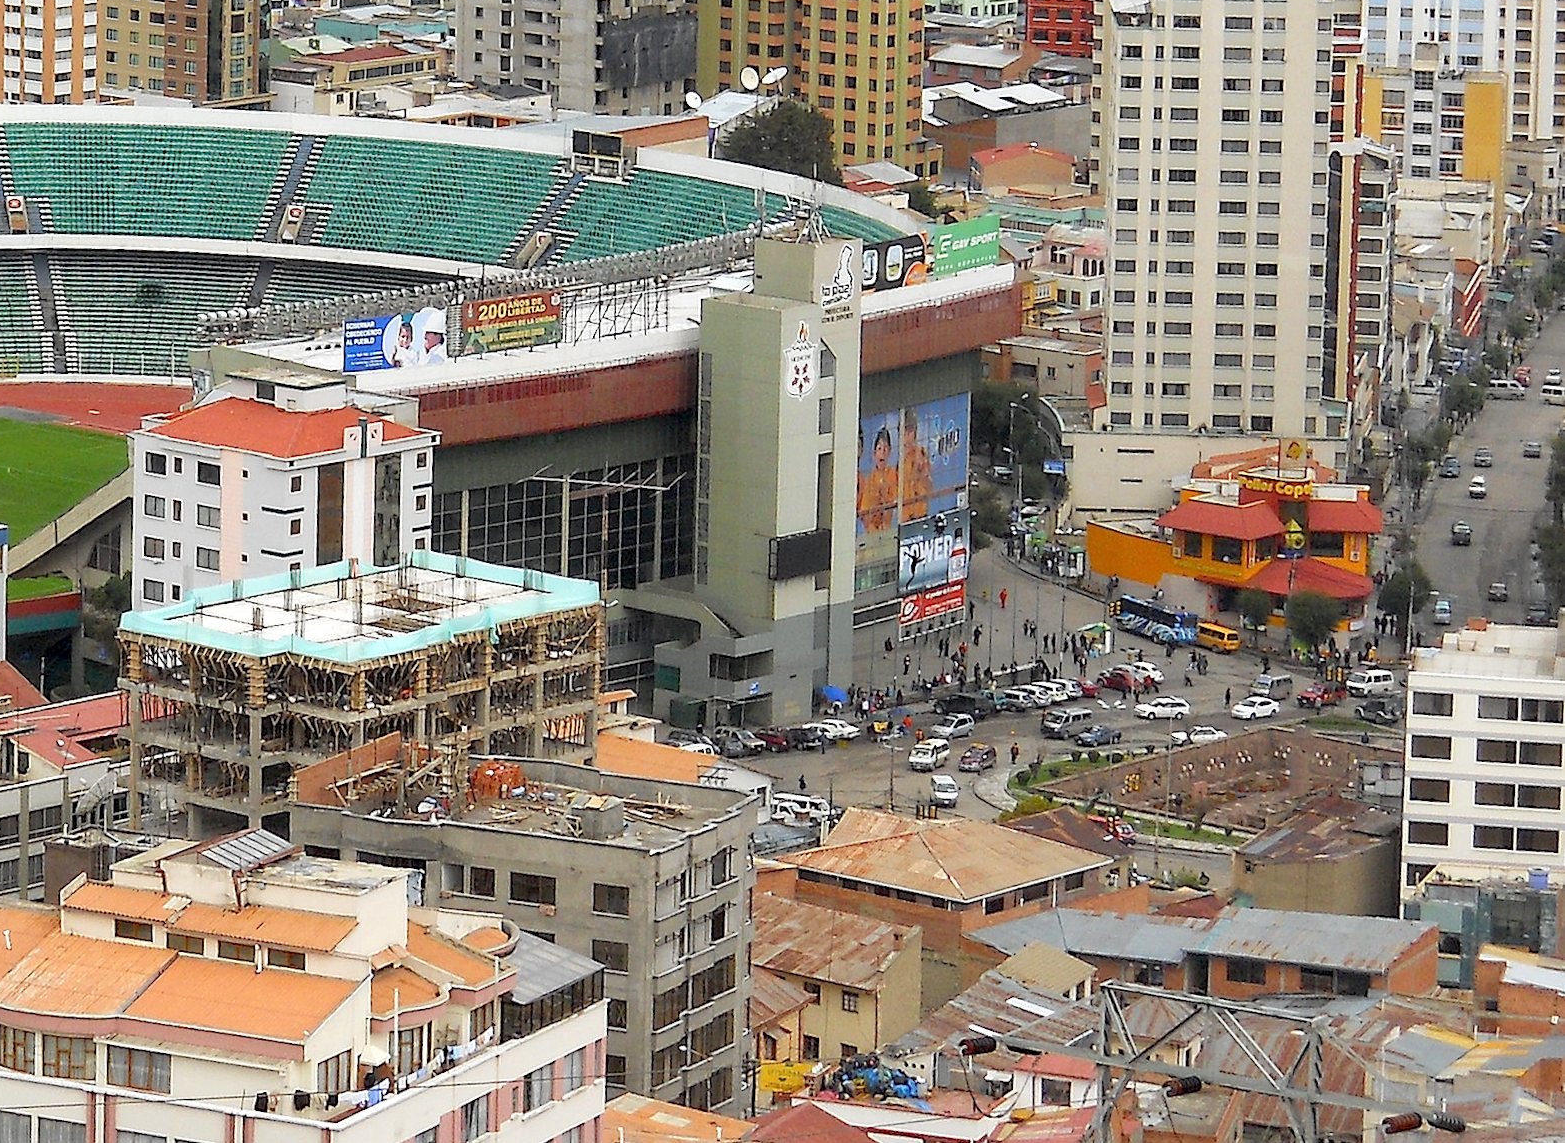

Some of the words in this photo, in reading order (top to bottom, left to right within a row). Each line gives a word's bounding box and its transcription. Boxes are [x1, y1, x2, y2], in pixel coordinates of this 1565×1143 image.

[970, 233, 998, 247] SPORT
[508, 298, 530, 308] AÑOS
[531, 297, 543, 306] DE
[478, 302, 507, 321] 200
[508, 304, 546, 317] LIBERTAD
[1239, 477, 1273, 492] Pollos
[899, 534, 953, 571] POWER
